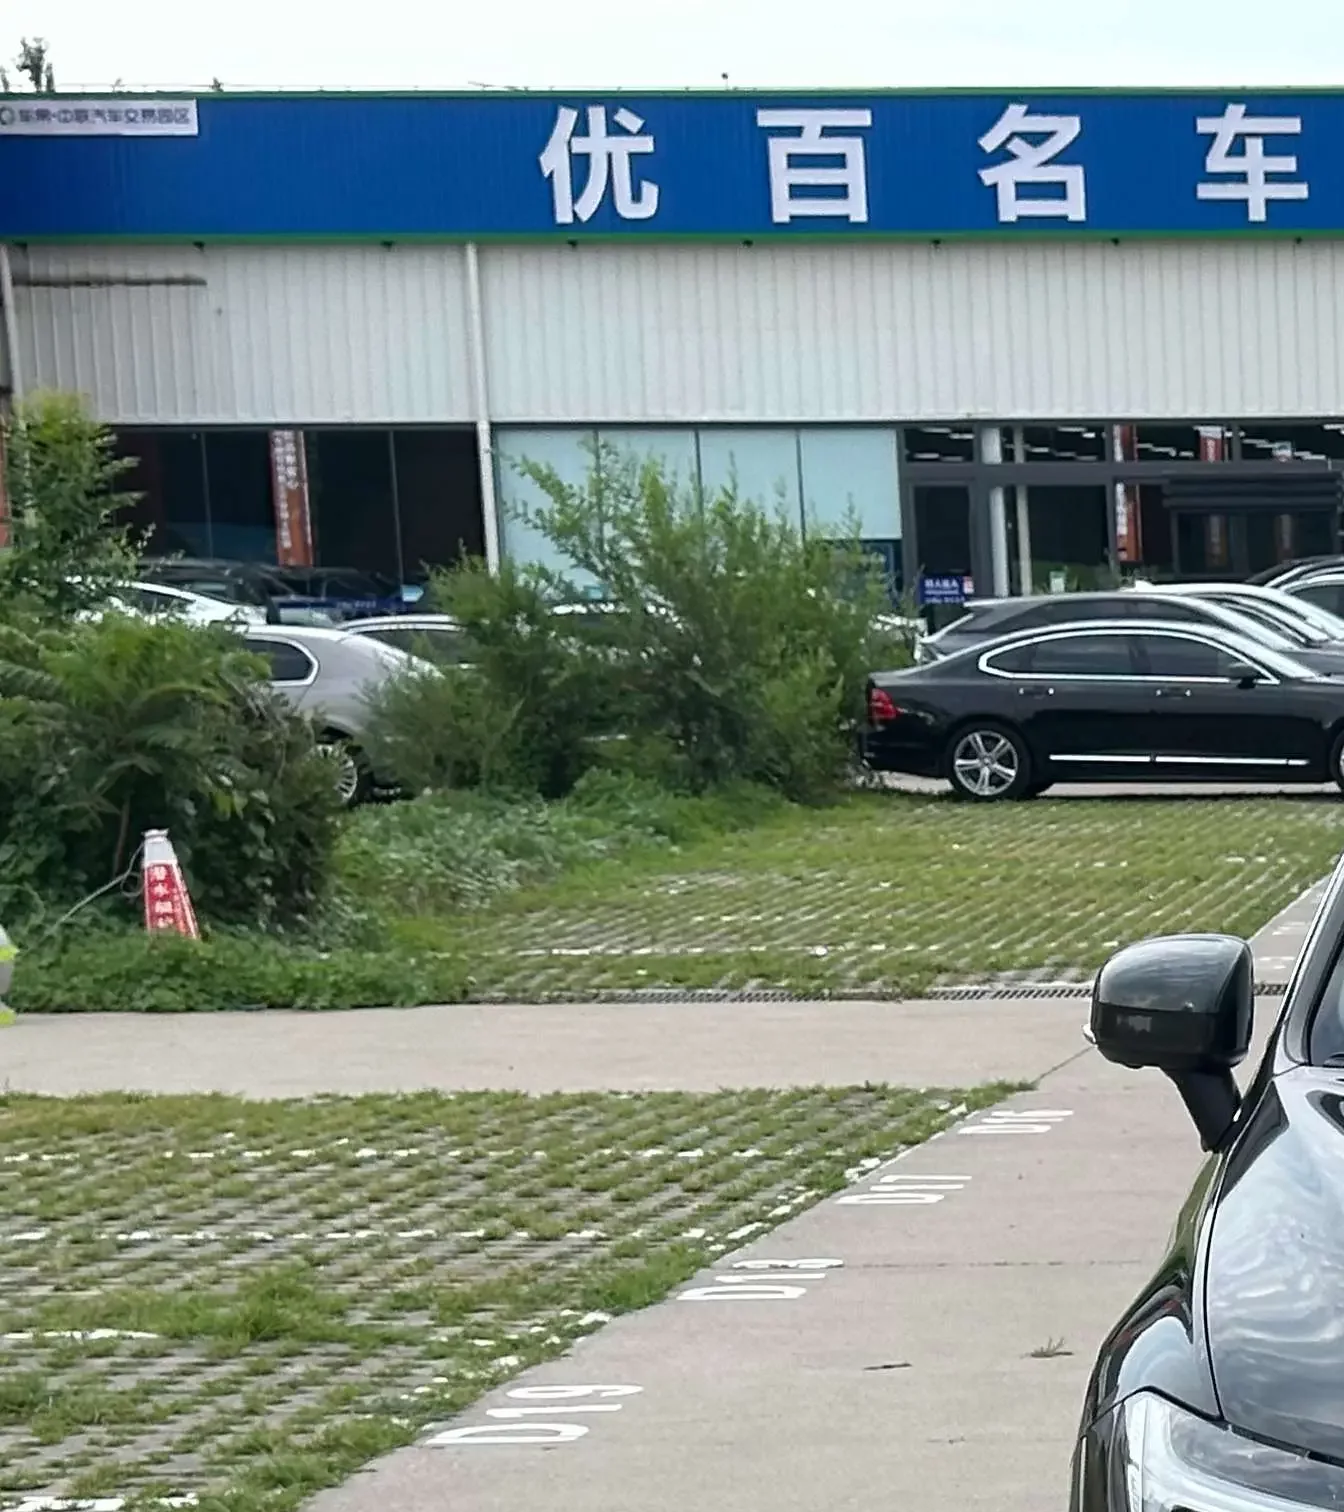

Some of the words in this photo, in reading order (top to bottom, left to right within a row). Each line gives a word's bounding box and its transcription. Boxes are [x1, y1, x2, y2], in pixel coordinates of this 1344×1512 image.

[539, 103, 1309, 225] 优百名车
[834, 1174, 973, 1205] D17
[424, 1384, 644, 1444] D19
